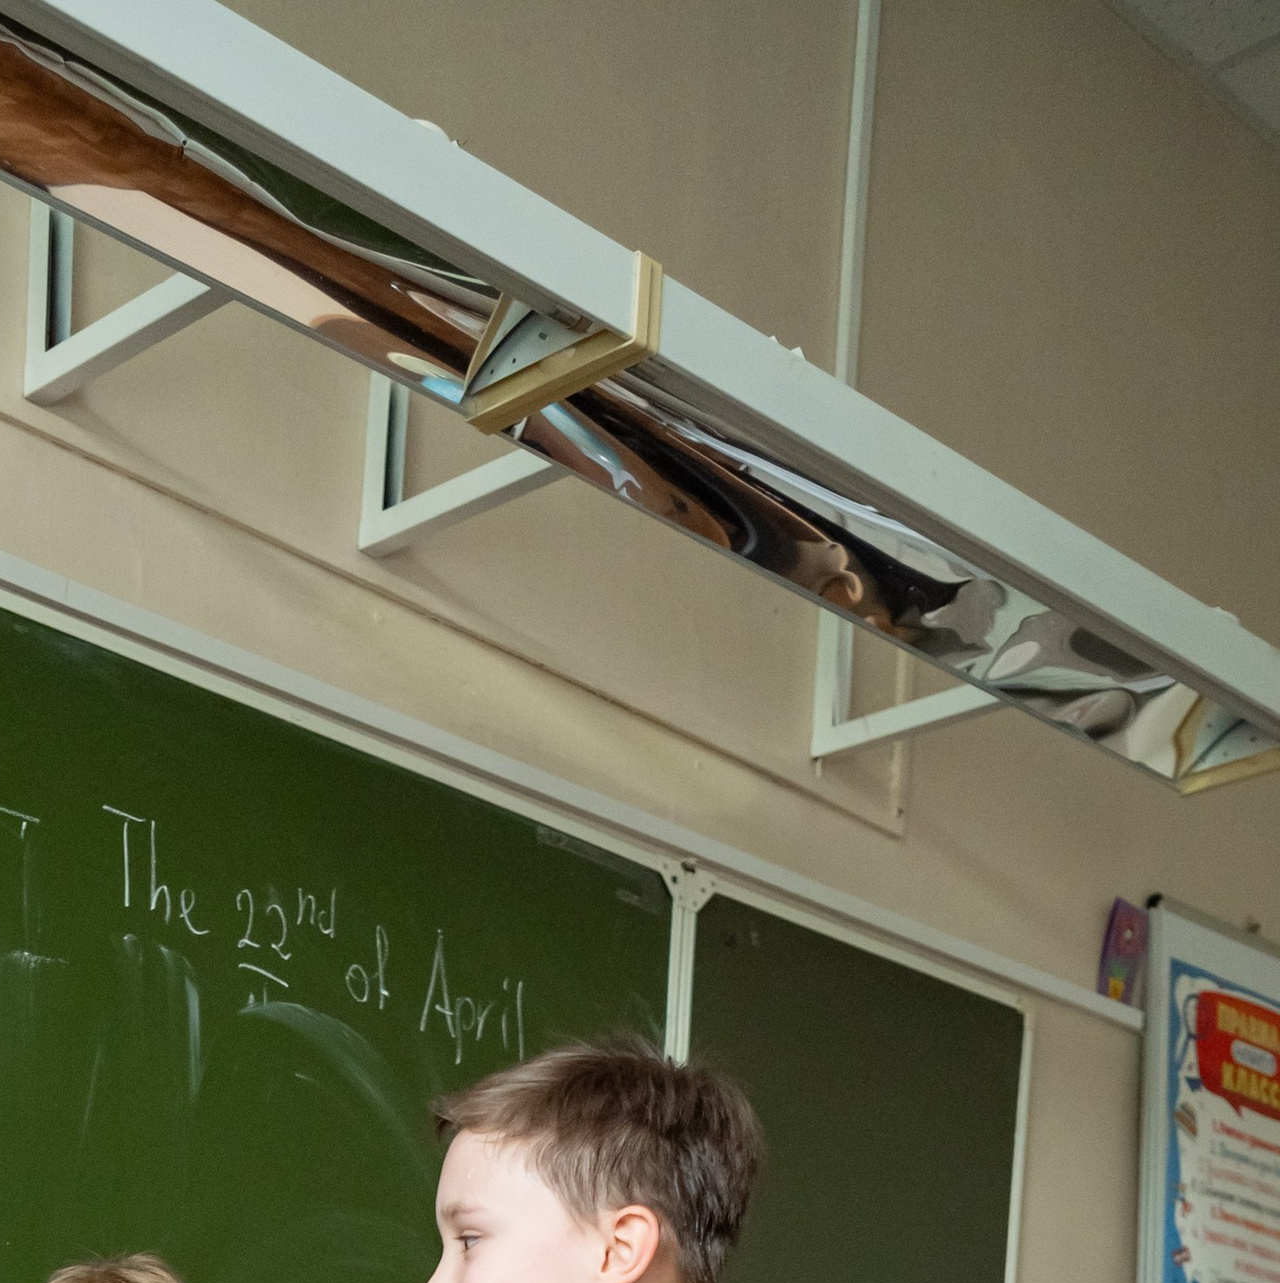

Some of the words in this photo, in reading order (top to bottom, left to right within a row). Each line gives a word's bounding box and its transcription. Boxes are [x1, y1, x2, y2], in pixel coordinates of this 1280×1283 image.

[102, 804, 210, 935] The
[345, 925, 390, 1009] of
[420, 929, 524, 1064] April
